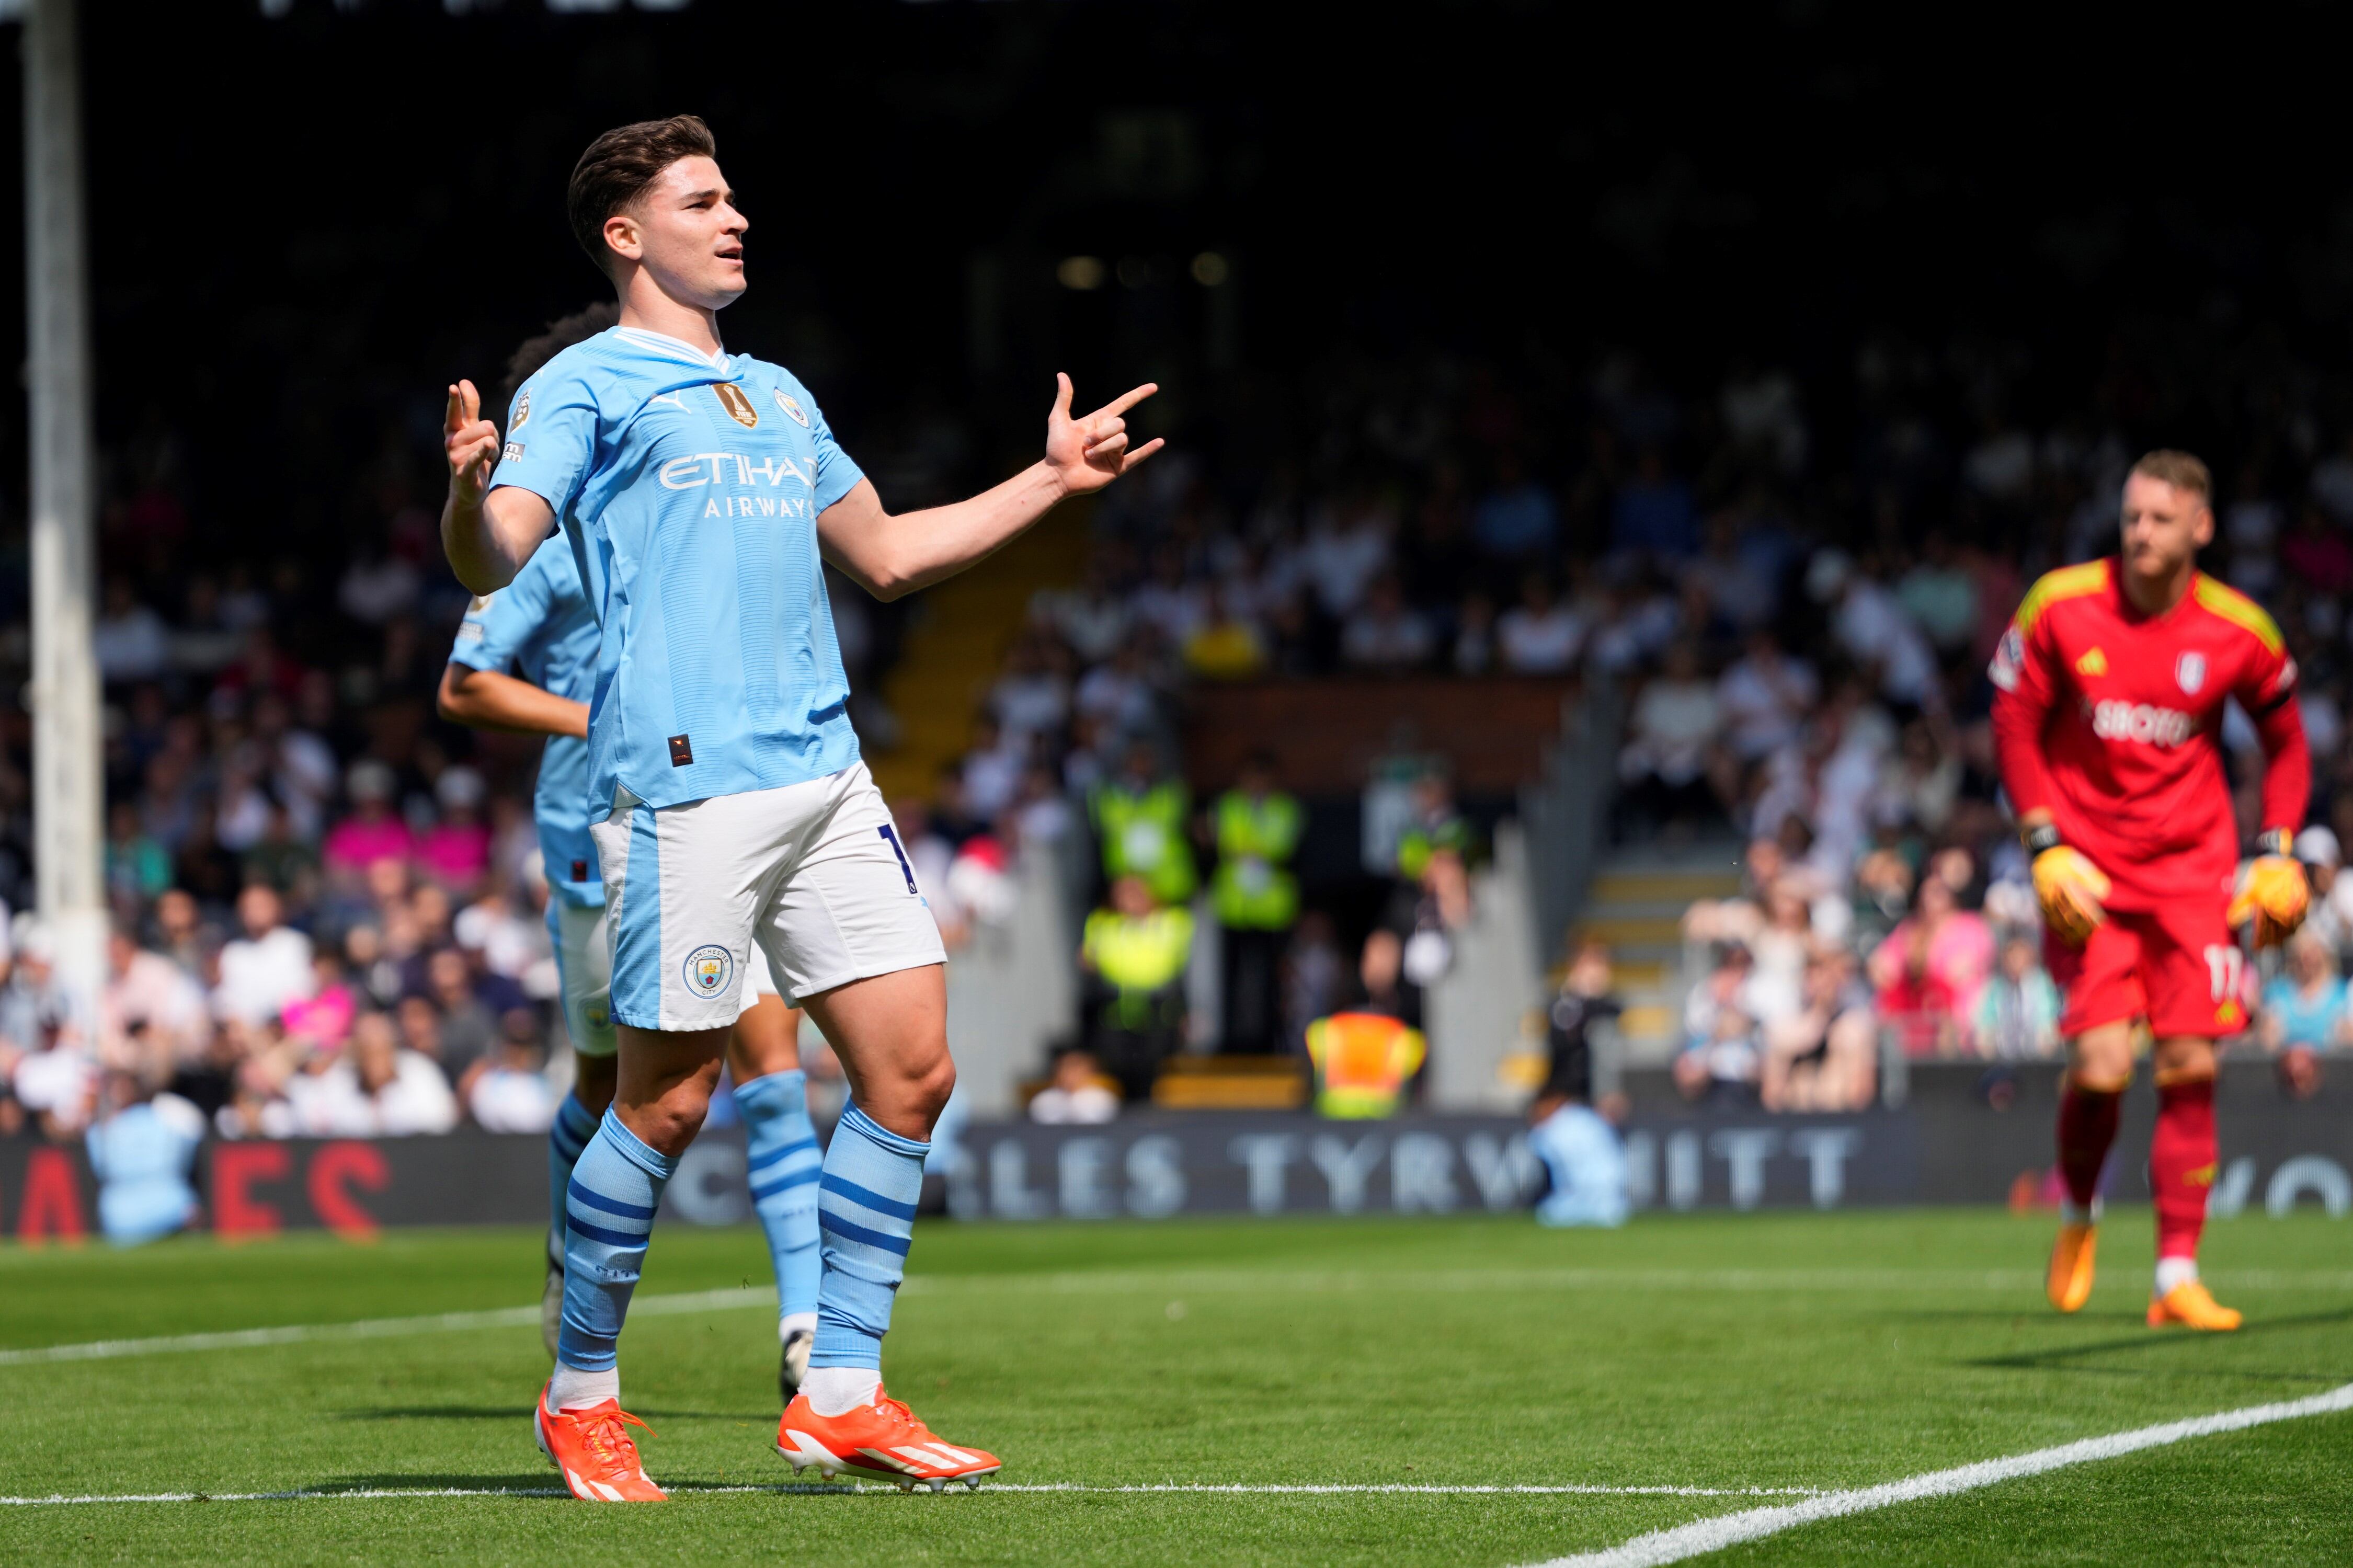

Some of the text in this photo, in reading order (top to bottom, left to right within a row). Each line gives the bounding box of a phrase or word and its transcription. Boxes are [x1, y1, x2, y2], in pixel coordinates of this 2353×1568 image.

[704, 497, 815, 519] AIRWAYS
[689, 949, 728, 966] MANCHESTER
[1227, 1127, 1863, 1216] TYRWITT
